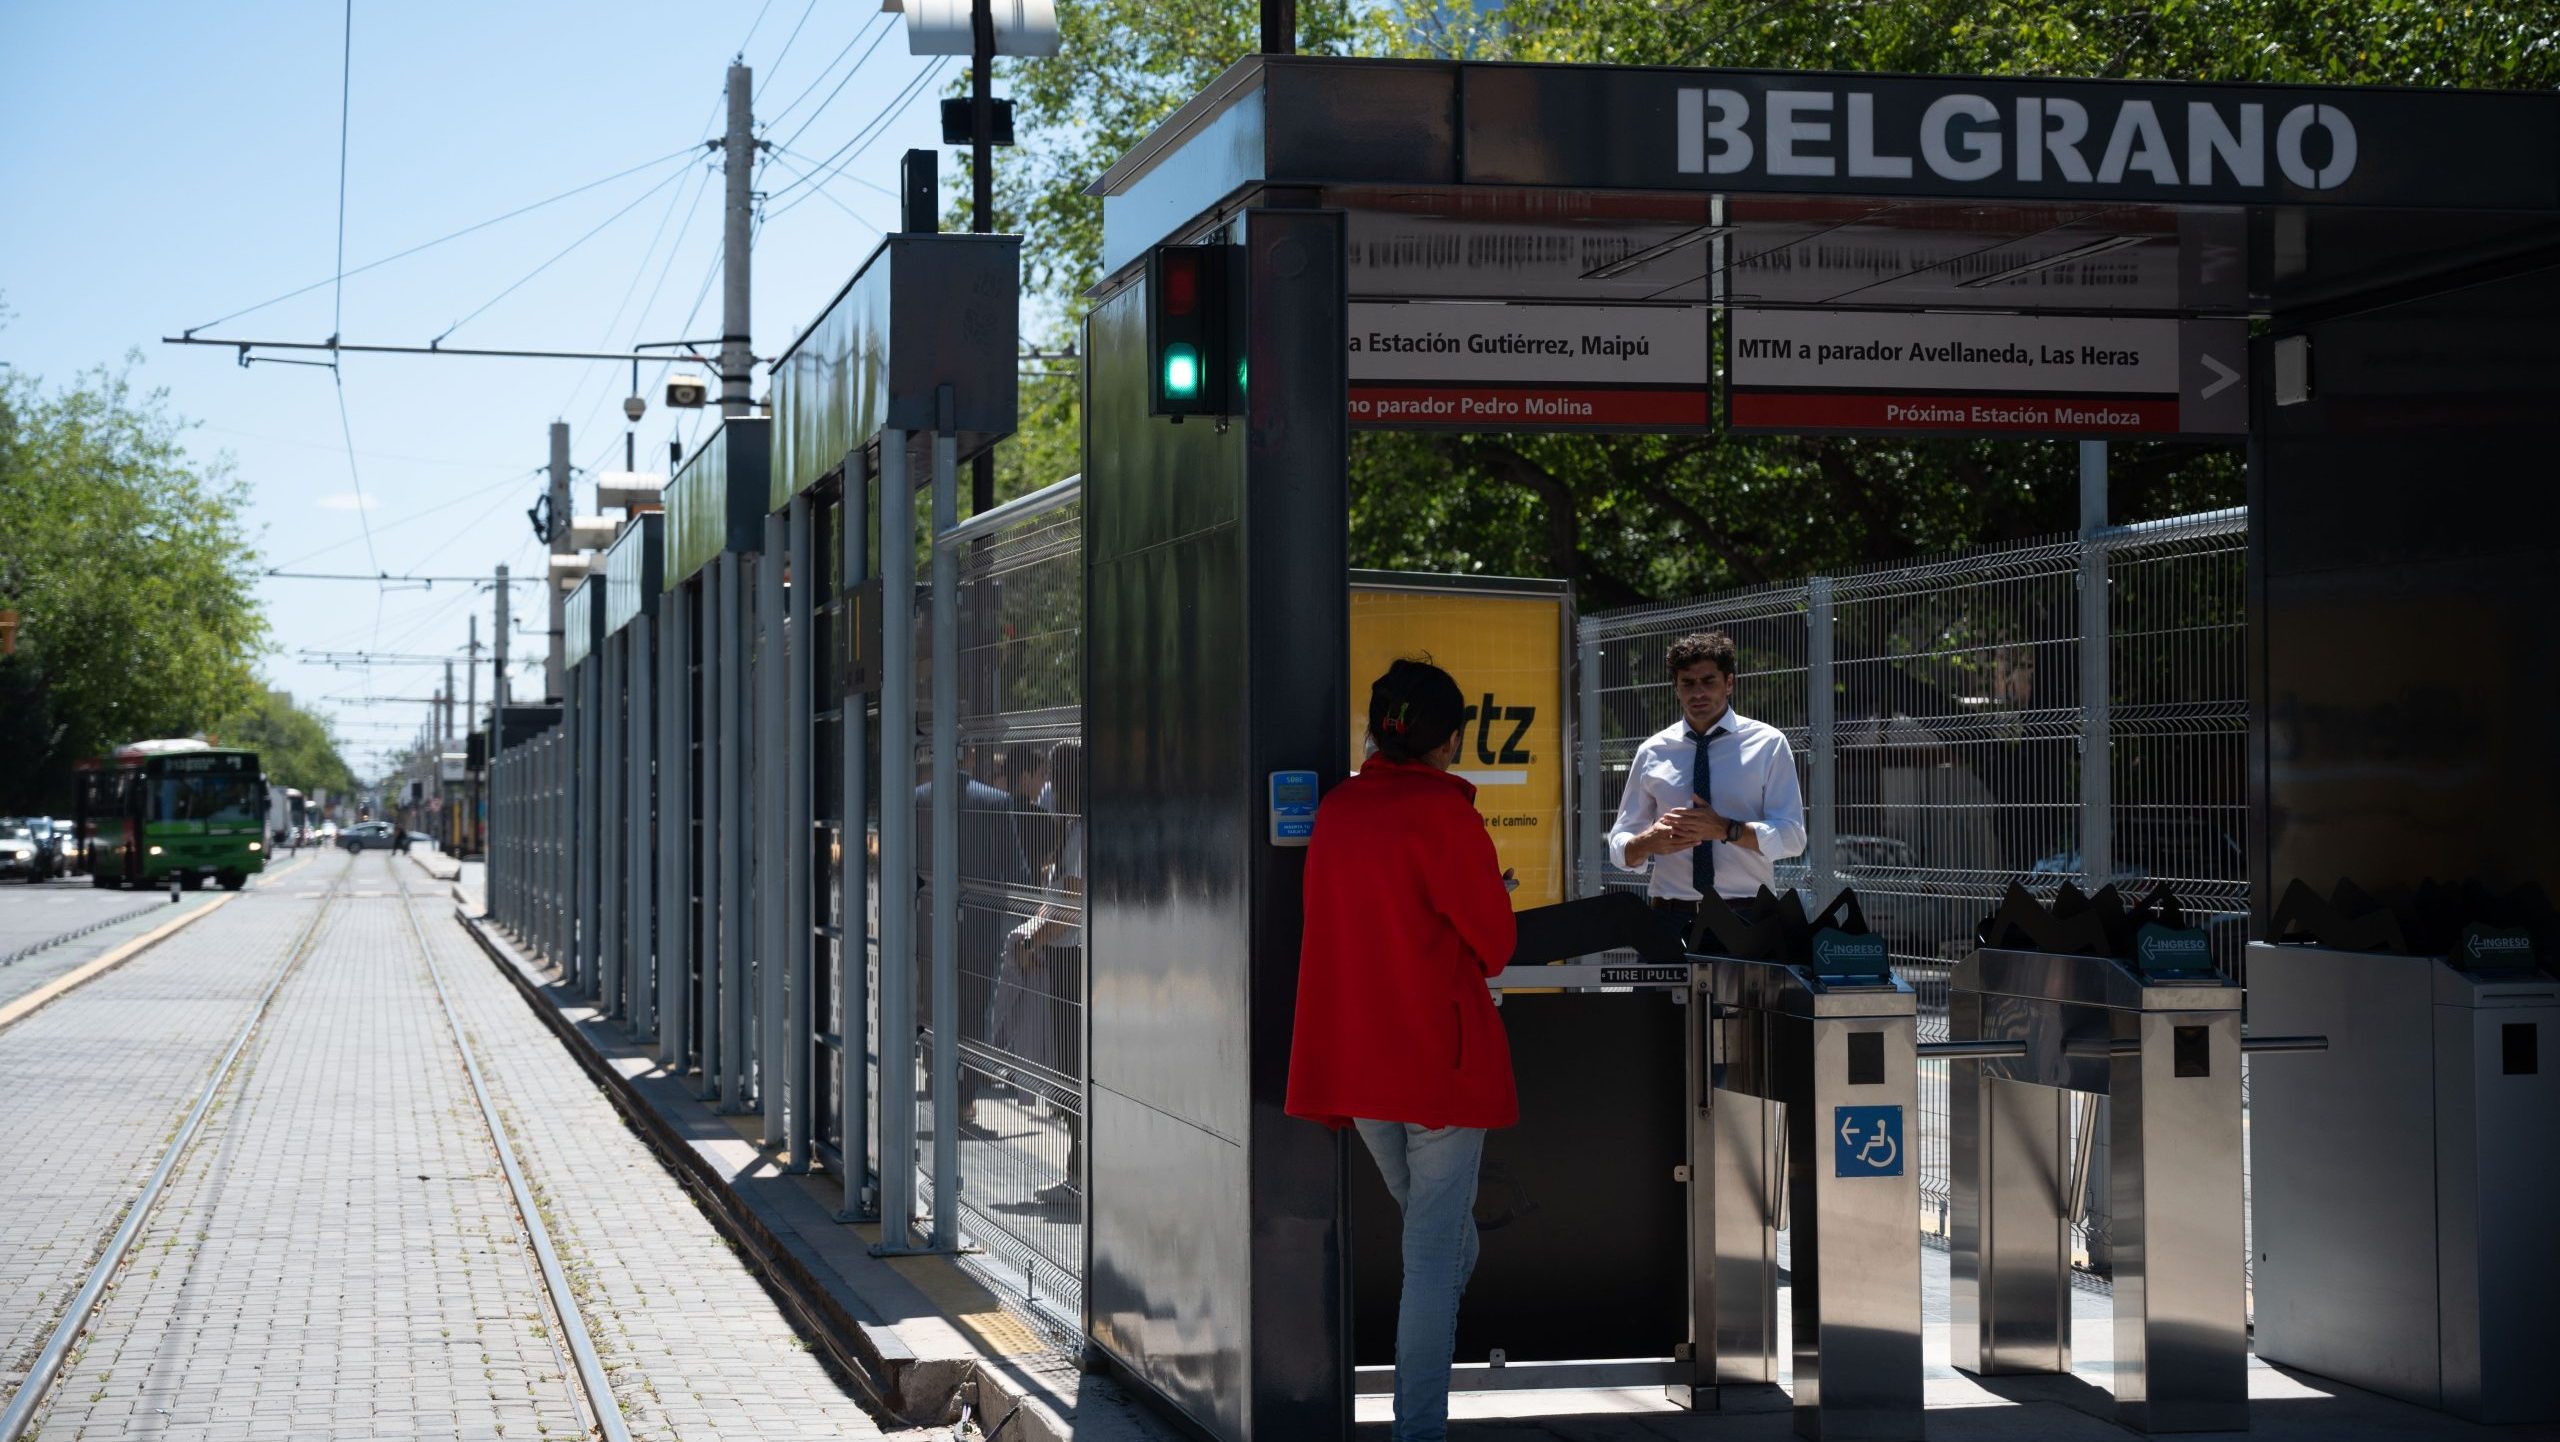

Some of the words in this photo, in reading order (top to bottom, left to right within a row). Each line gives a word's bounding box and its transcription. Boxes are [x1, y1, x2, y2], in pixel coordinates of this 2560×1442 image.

[1676, 86, 2359, 190] BELGRANO
[1349, 337, 1361, 352] a
[1369, 332, 1461, 354] Estación
[1468, 333, 1575, 358] Gutiérrez,
[1581, 335, 1650, 361] Maipú
[1738, 338, 1792, 360] MTM
[1799, 343, 1811, 360] a
[1818, 339, 1903, 365] parador
[1908, 341, 2034, 367] Avellaneda,
[2040, 345, 2074, 365] Las
[2081, 346, 2140, 366] Heras
[1377, 396, 1456, 419] parador
[1461, 396, 1519, 414] Pedro
[1525, 397, 1593, 416] Molina
[1887, 403, 1966, 423] Próxima
[1971, 405, 2049, 425] Estación
[2055, 407, 2141, 427] Mendoza
[1491, 814, 1500, 827] el
[1502, 813, 1538, 827] camino
[1834, 944, 1883, 954] INGRESO
[2157, 939, 2206, 949] INGRESO
[2483, 937, 2530, 947] INGRESO
[1607, 970, 1638, 981] TIRE
[1647, 969, 1682, 981] PULL
